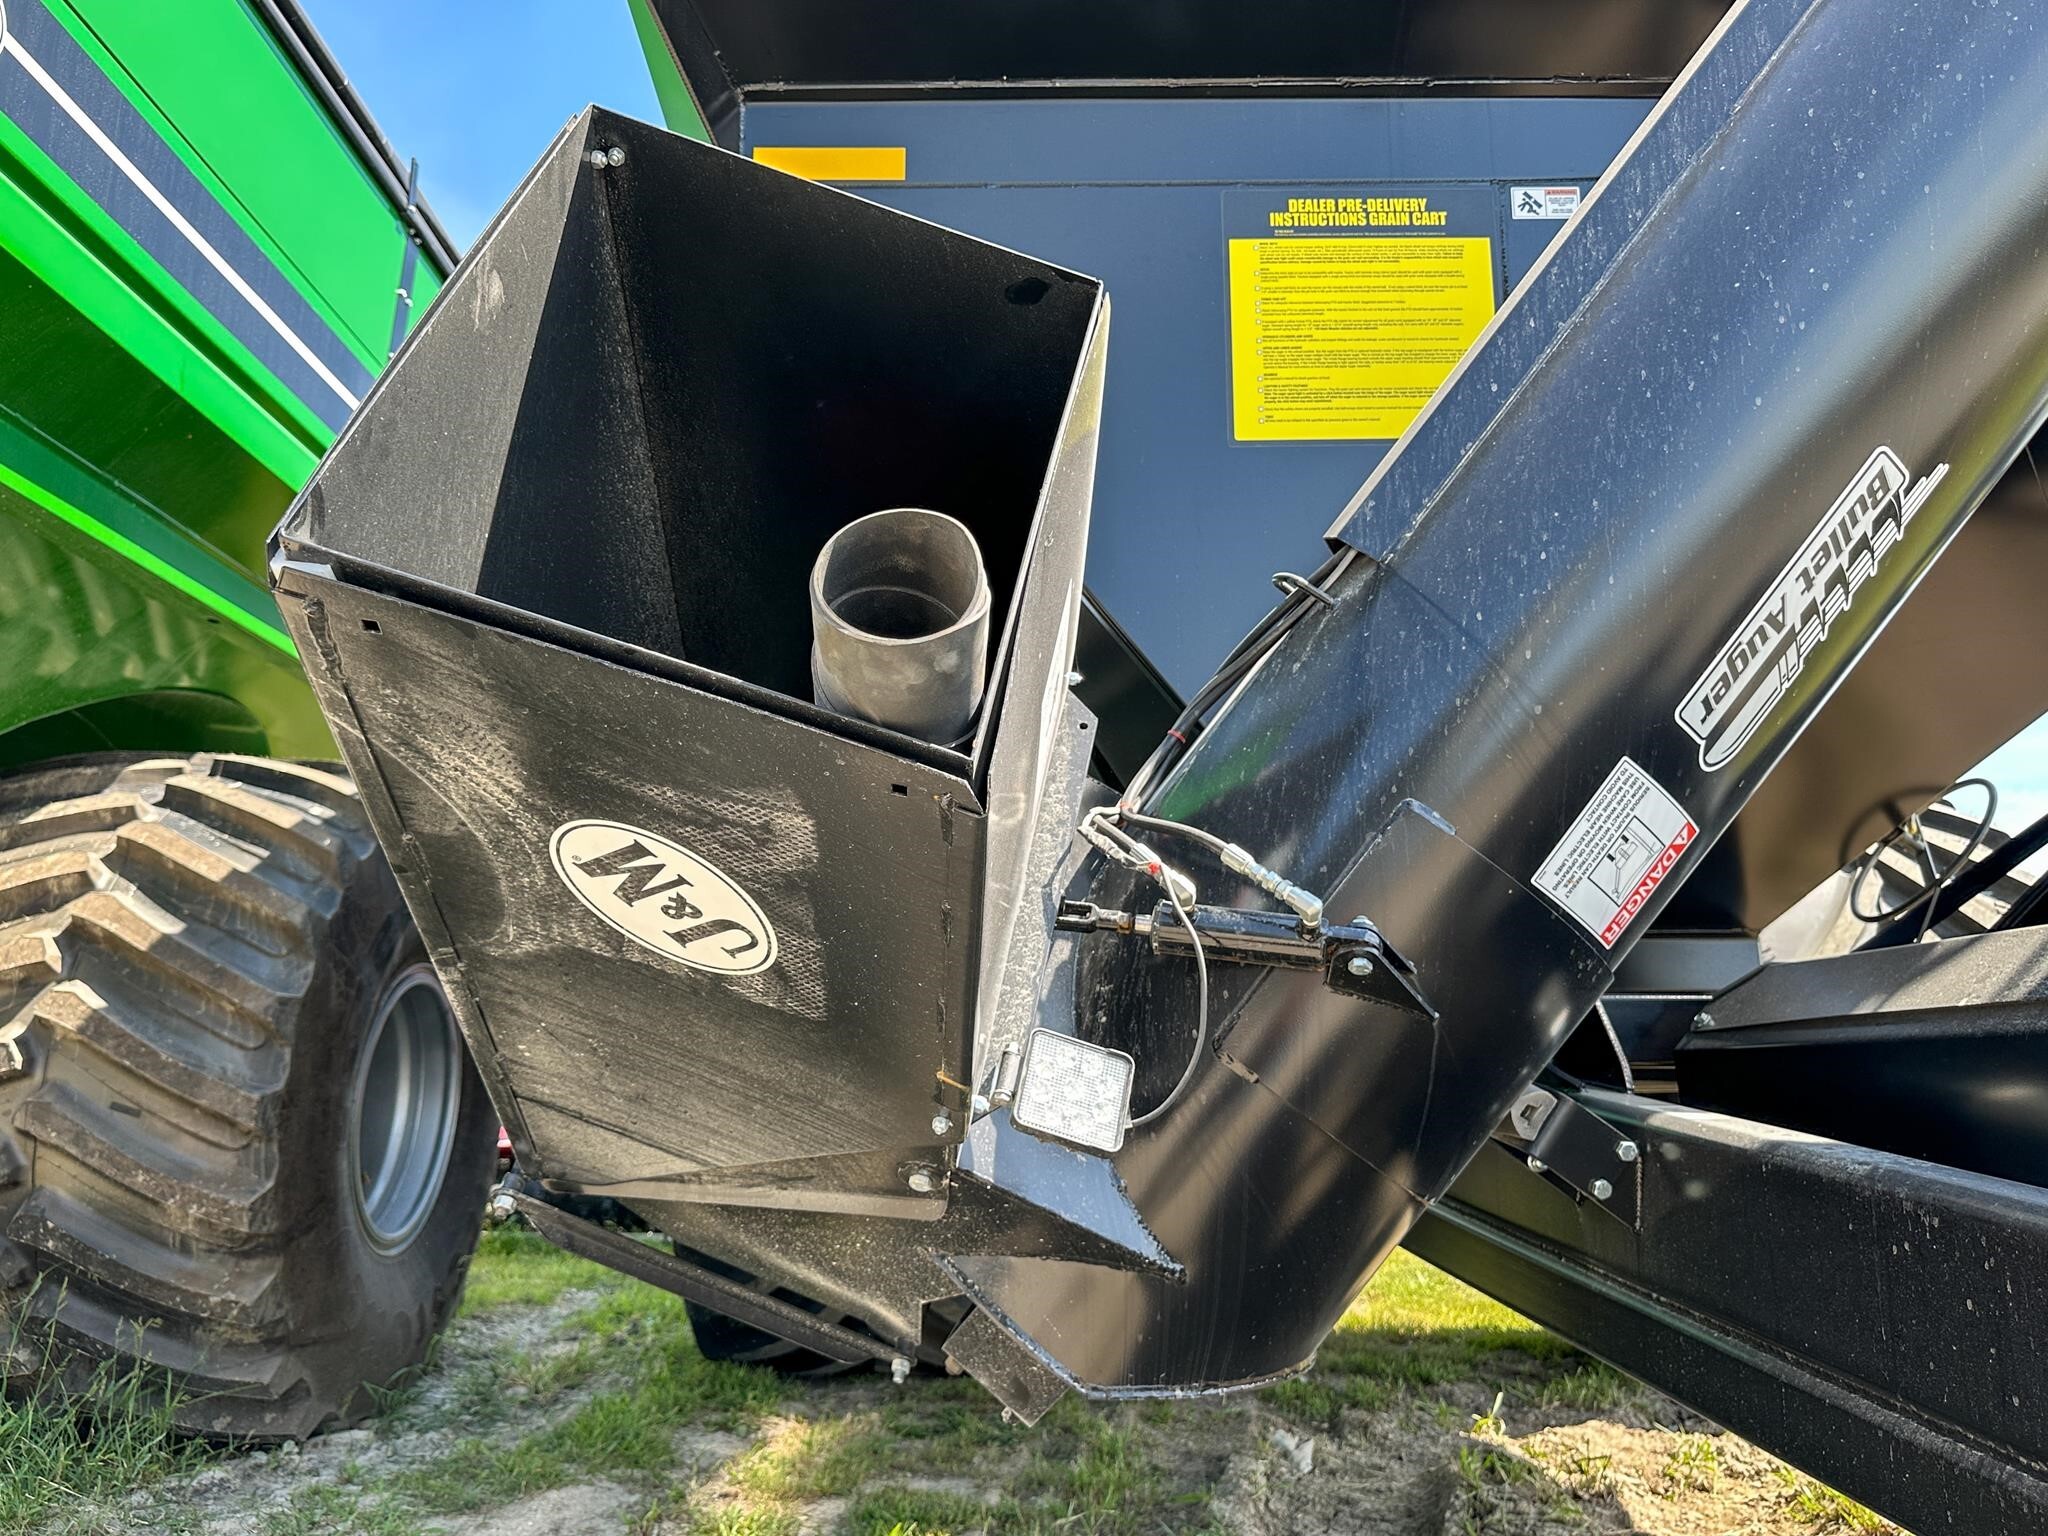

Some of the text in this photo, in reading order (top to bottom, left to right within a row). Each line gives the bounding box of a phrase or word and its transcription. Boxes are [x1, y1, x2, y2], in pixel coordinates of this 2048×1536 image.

[1288, 198, 1428, 213] DEALER PRE-DELIVERY
[1269, 211, 1447, 226] INSTRUCTIONS GRAIN CART
[1699, 465, 1892, 725] Bullet Auger
[1619, 767, 1628, 776] TO
[1621, 772, 1634, 785] THIS
[1606, 775, 1621, 794] AVOID
[1630, 781, 1644, 799] FROM
[1601, 785, 1623, 812] MACHINE
[1589, 812, 1603, 829] NEAR
[1610, 798, 1631, 827] CONTACT
[1551, 776, 1639, 891] USE CARE WHEN MOVING OR OPERATING
[1564, 786, 1650, 898] SERIOUS INJURY OR DEATH CAN RESULT
[1567, 829, 1590, 858] ELECTRIC
[1597, 826, 1611, 842] WITH
[1576, 841, 1599, 871] ELECTRIC
[1604, 847, 1676, 941] DANGER
